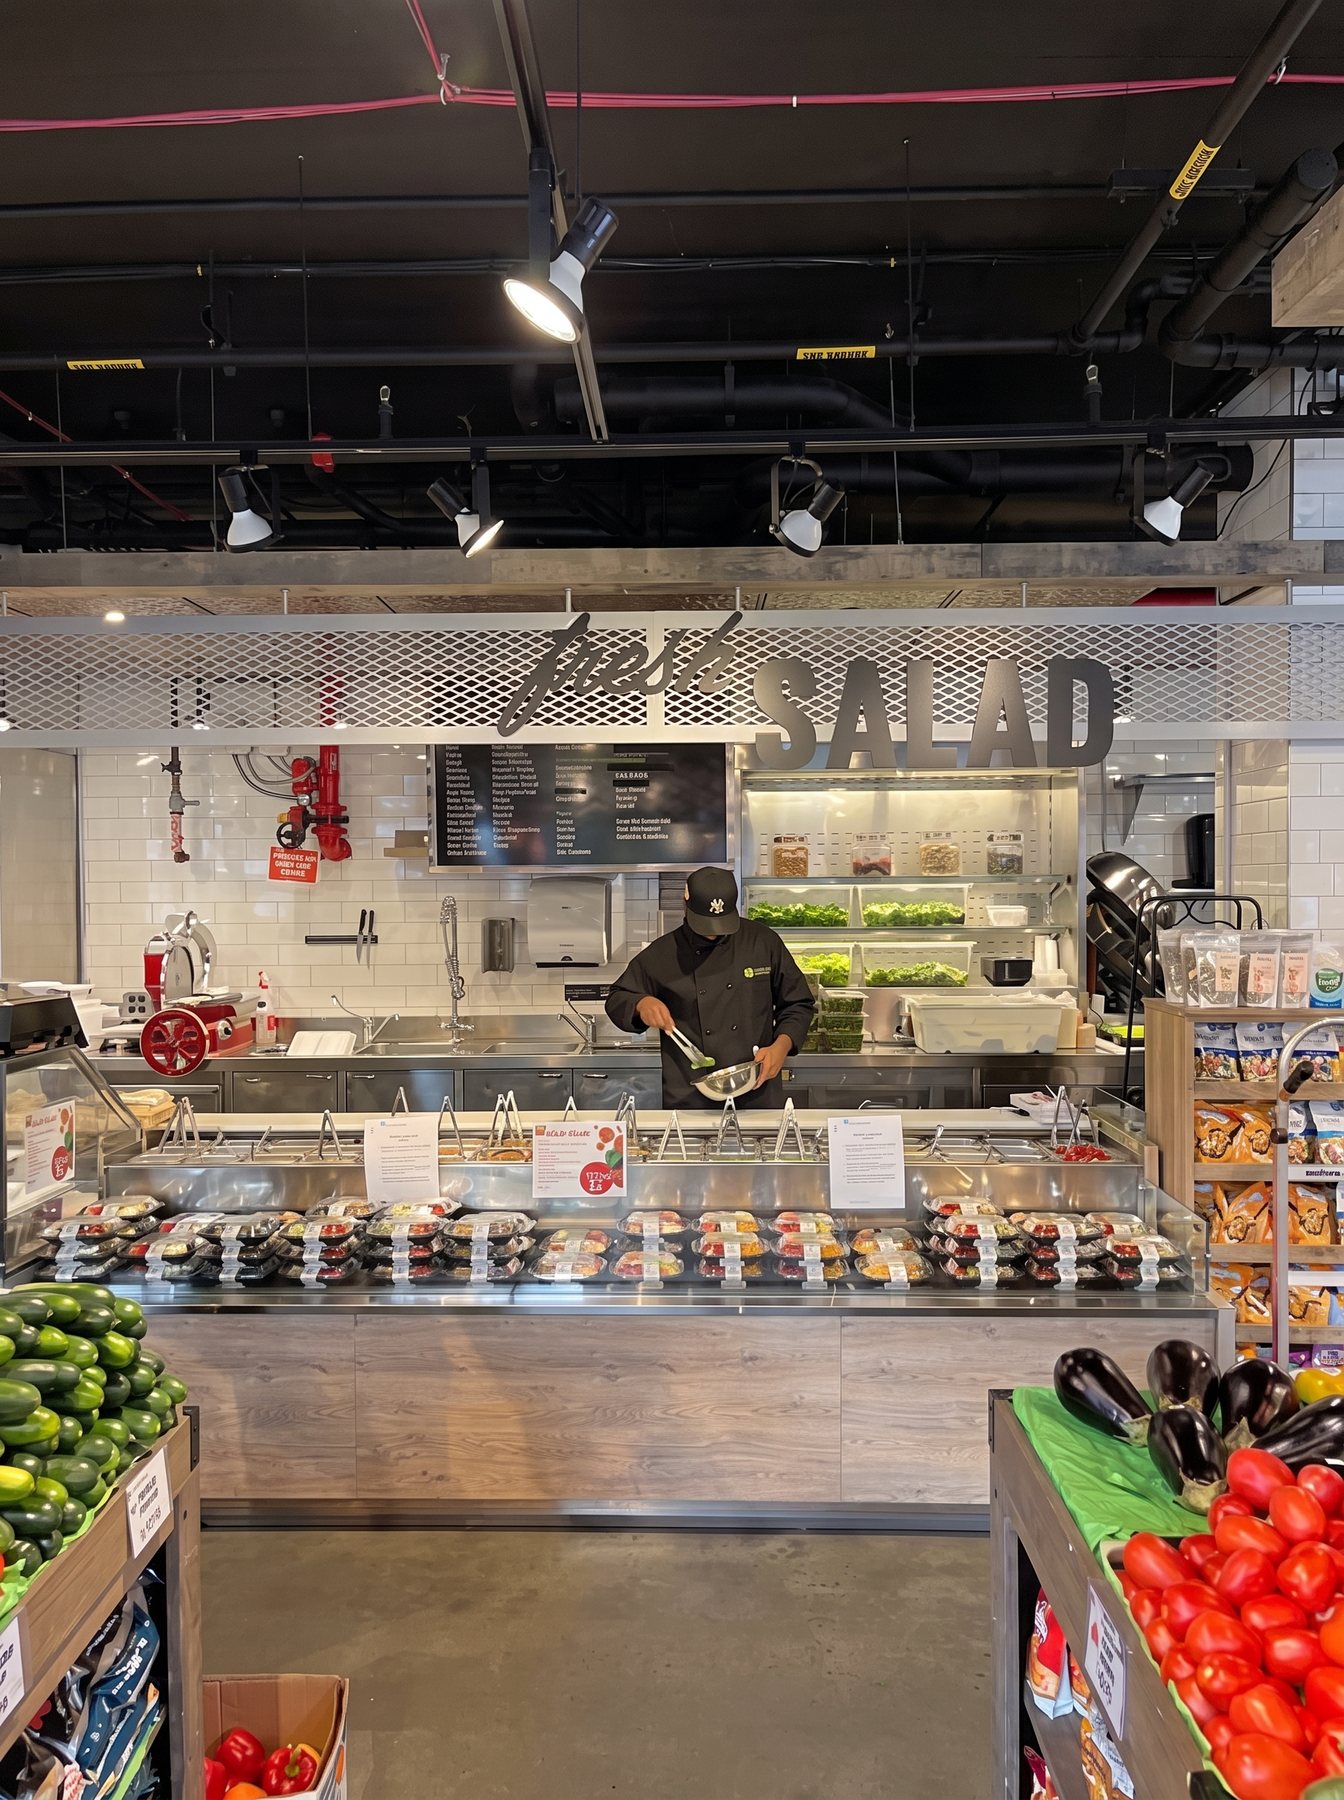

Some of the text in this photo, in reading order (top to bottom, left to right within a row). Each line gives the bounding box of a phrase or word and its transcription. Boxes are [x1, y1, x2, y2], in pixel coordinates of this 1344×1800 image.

[497, 611, 743, 737] fresh
[752, 657, 1115, 769] SALAD
[709, 898, 725, 914] NY
